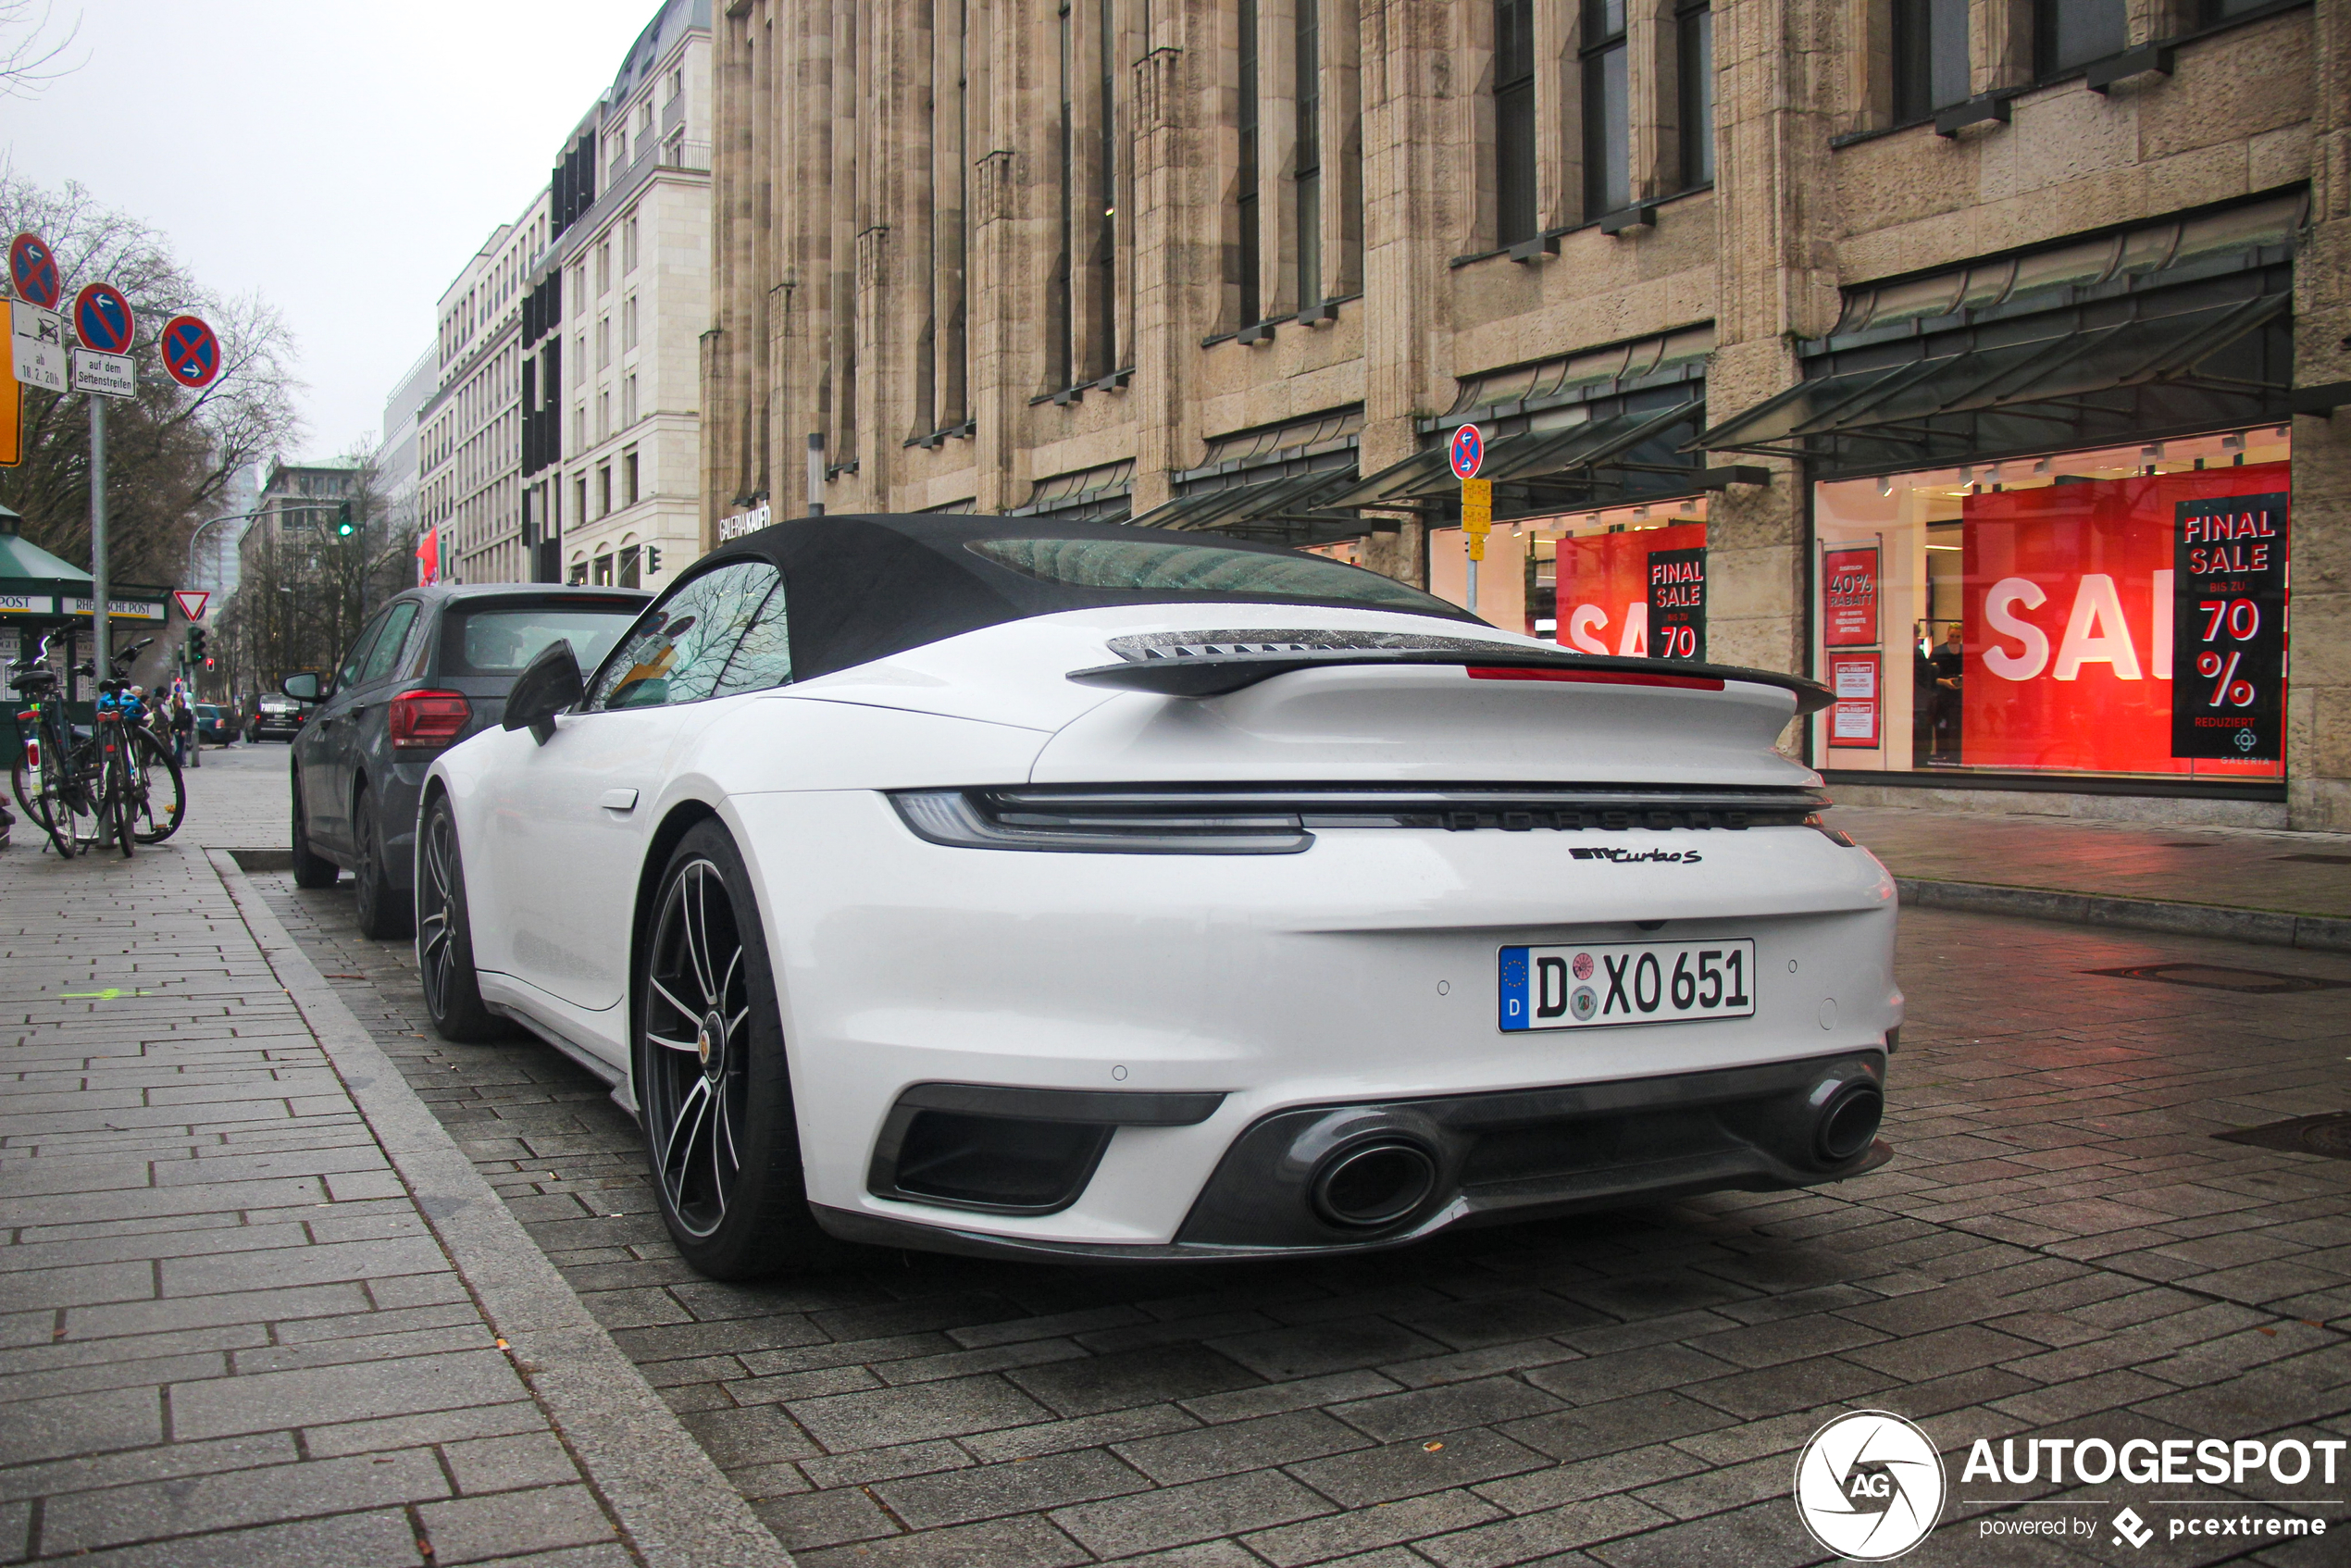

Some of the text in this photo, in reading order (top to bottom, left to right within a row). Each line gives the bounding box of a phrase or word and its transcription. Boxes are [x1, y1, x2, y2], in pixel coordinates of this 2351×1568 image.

[35, 354, 45, 366] ab
[89, 360, 121, 374] auf dem
[44, 370, 59, 386] 20h
[78, 371, 131, 389] Seitenstreifen
[719, 514, 746, 541] GALERIA
[2184, 511, 2276, 543] FINAL
[2189, 544, 2269, 574] SALE
[1651, 561, 1704, 585] FINAL
[2209, 581, 2245, 592] BIS ZU
[1656, 585, 1700, 607] SALE
[1830, 594, 1872, 607] RABATT
[129, 604, 151, 615] POST
[1667, 612, 1689, 622] BIS ZU
[2199, 597, 2260, 642] 70
[1661, 625, 1697, 659] 70
[2196, 651, 2255, 707] %
[2195, 716, 2256, 728] REDUZIERT
[2220, 756, 2270, 766] GALERIA
[1682, 850, 1702, 865] S
[1536, 956, 1567, 1018] D
[1602, 952, 1661, 1014] XO
[1671, 949, 1748, 1010] 651
[1509, 999, 1521, 1016] D
